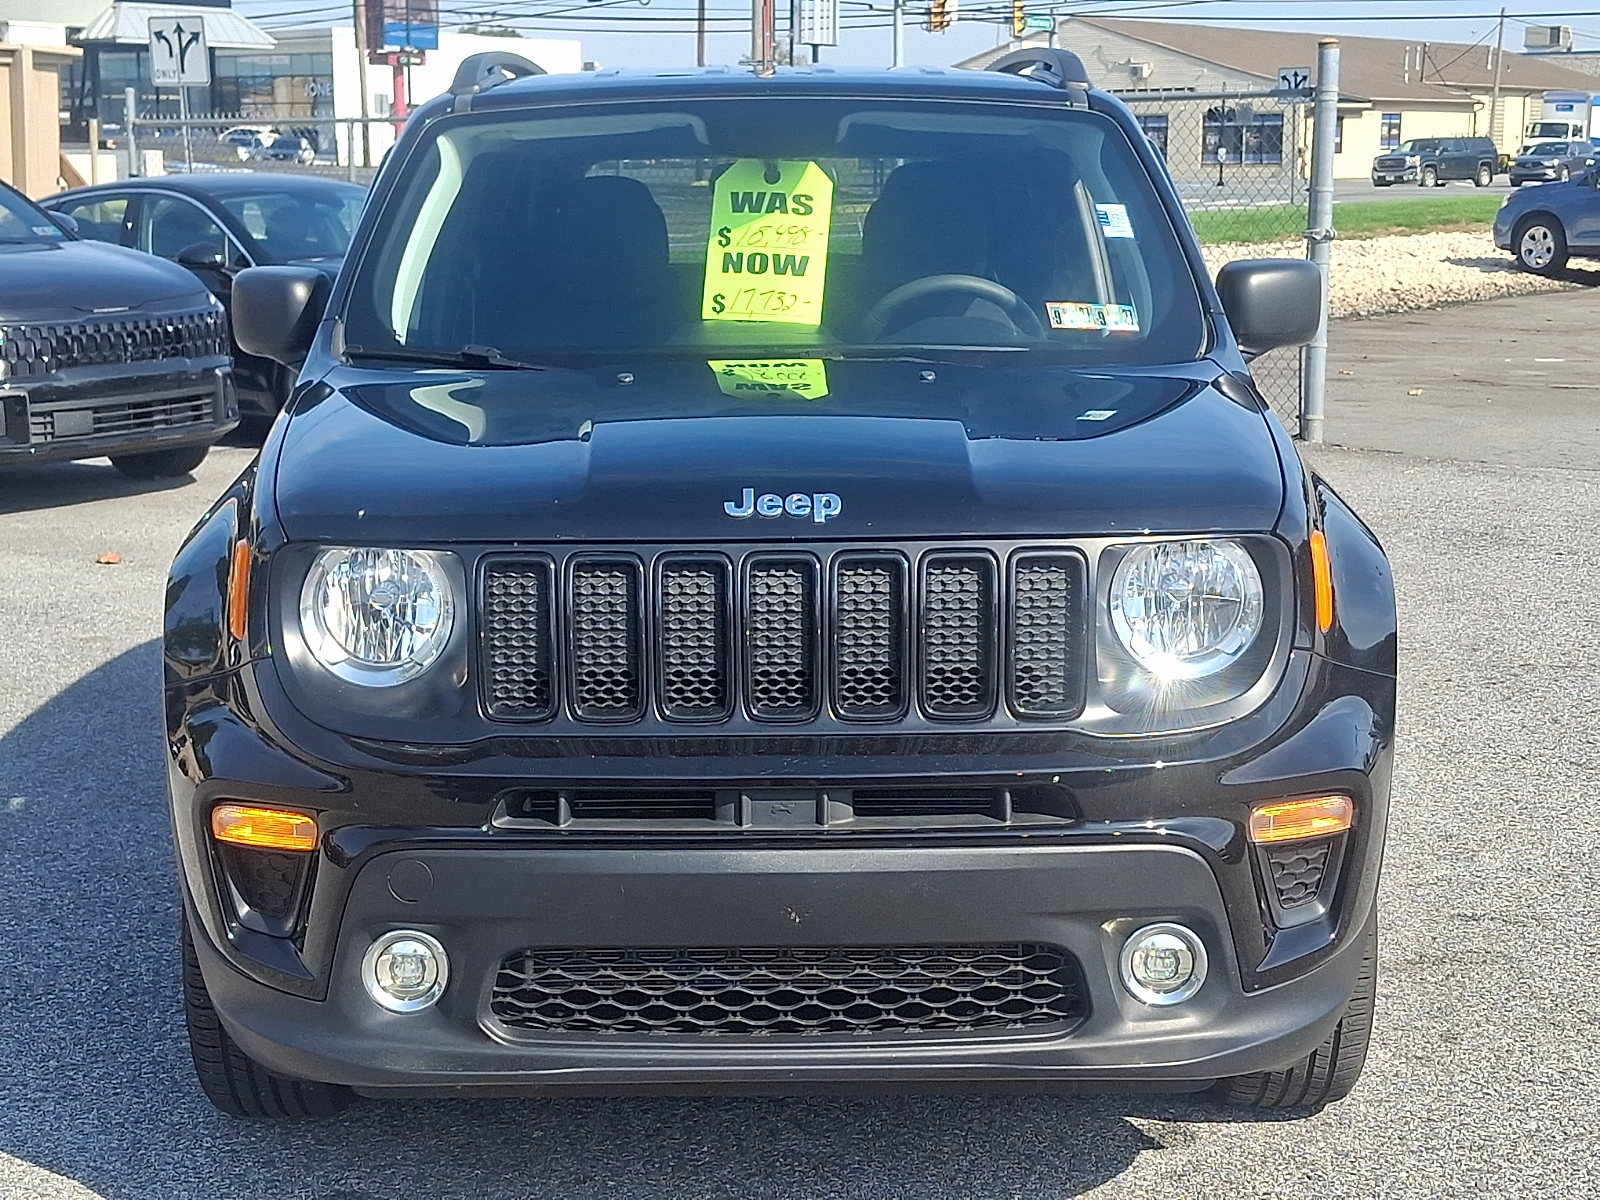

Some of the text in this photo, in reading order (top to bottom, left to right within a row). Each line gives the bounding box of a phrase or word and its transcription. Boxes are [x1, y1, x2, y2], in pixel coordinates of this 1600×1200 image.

[730, 191, 813, 216] WAS
[722, 252, 810, 277] NOW
[723, 487, 842, 523] Jeep
